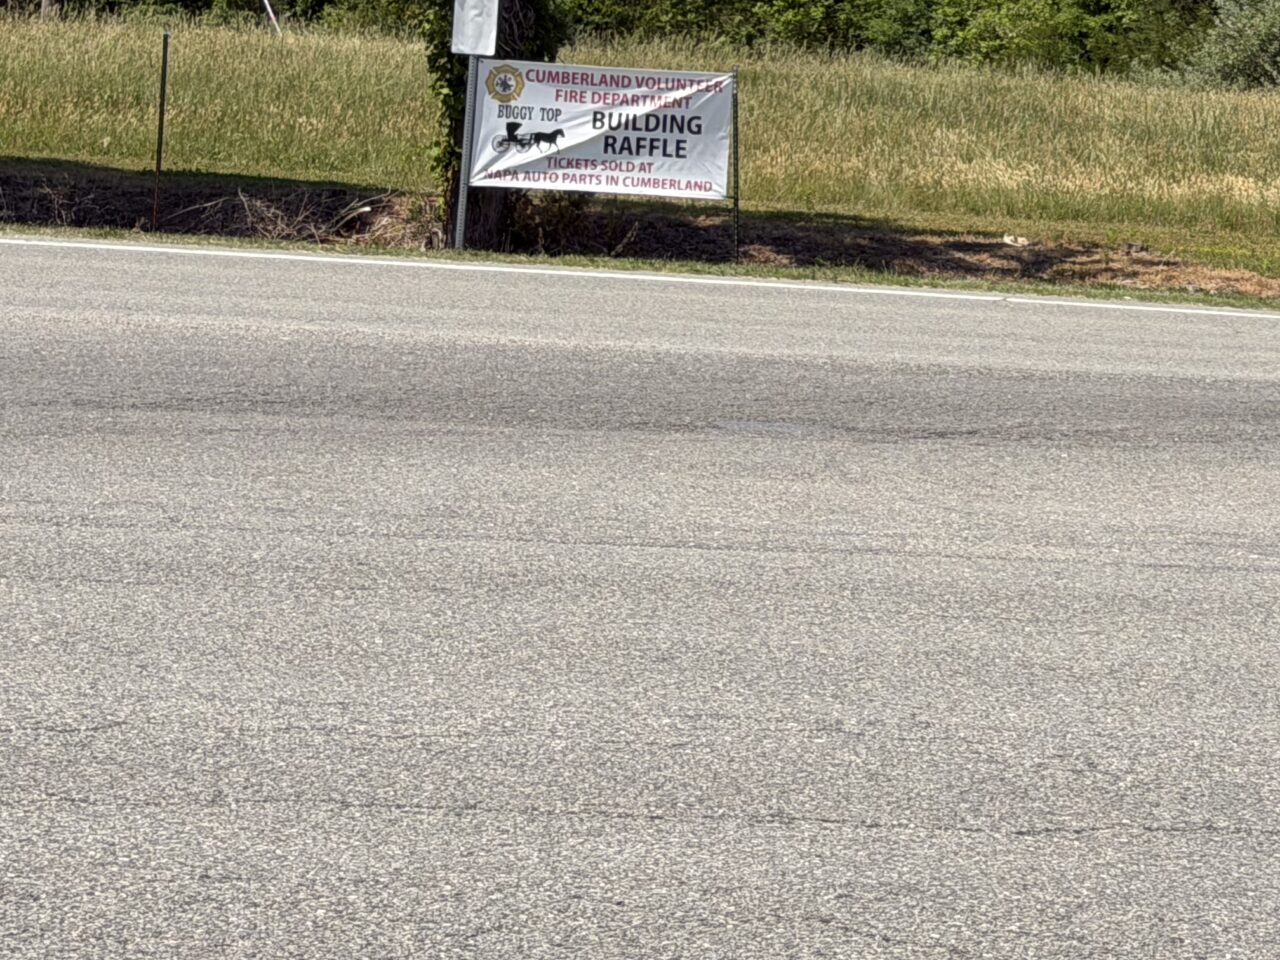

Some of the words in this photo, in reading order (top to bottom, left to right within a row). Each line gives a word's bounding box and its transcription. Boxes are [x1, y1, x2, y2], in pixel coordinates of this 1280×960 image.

[525, 68, 632, 88] CUMBERLAND
[635, 76, 723, 93] VOLUNTEER
[555, 89, 587, 103] FIRE
[591, 91, 692, 109] DEPARTMENT
[497, 104, 534, 121] BUGGY
[540, 107, 562, 122] TOP
[592, 111, 702, 135] BUILDING
[603, 135, 687, 158] RAFFLE
[546, 157, 598, 171] TICKETS
[601, 160, 635, 173] SOLD
[638, 162, 654, 174] AT
[484, 168, 520, 182] NAPA
[523, 171, 559, 183] AUTO
[562, 172, 602, 185] PARTS
[605, 175, 619, 186] IN
[622, 176, 713, 192] CUMBERLAND
